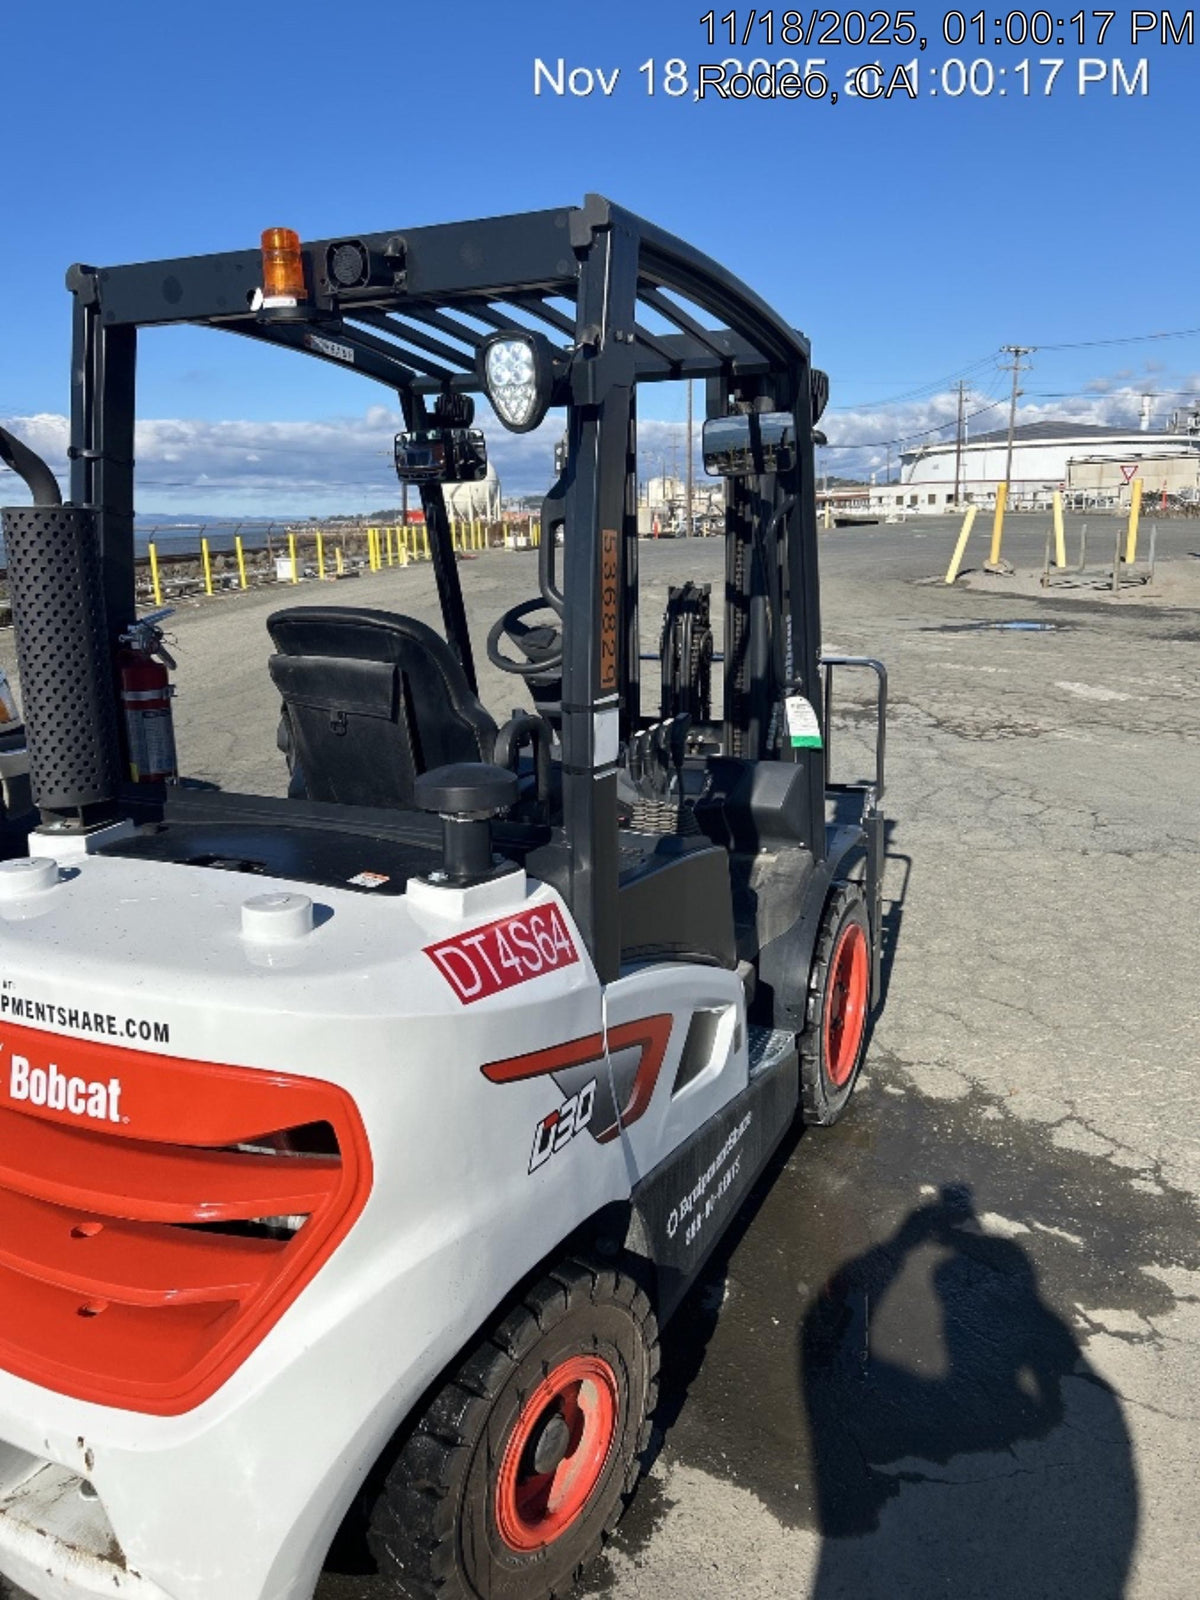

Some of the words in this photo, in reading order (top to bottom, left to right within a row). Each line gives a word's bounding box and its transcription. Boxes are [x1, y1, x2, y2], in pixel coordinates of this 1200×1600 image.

[602, 535, 616, 683] 536829
[433, 909, 572, 998] DT4S64
[1, 994, 170, 1043] PMENTSHARE.COM
[10, 1053, 122, 1123] Bobcat
[527, 1076, 598, 1176] D30
